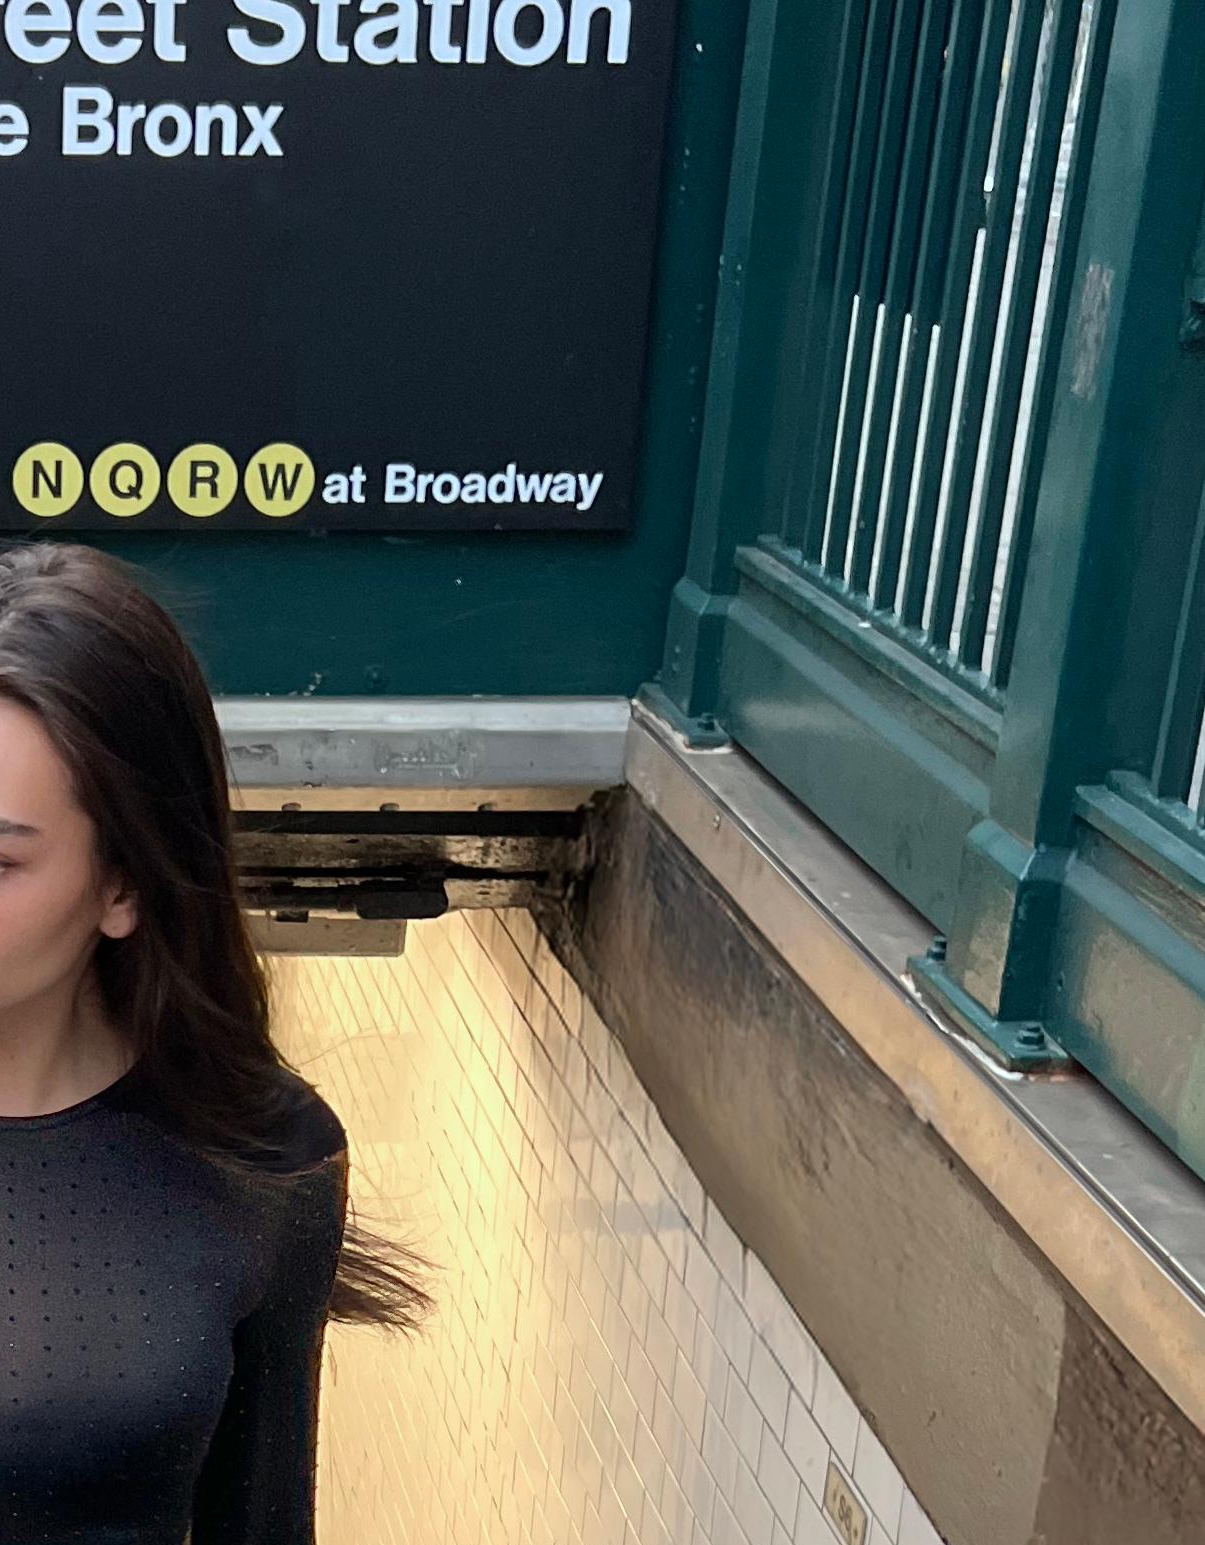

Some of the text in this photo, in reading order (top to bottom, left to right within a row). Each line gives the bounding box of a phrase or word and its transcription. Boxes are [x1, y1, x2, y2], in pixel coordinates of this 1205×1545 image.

[226, 0, 632, 66] Station
[61, 85, 284, 158] Bronx
[31, 459, 604, 511] N Q R W at Broadway
